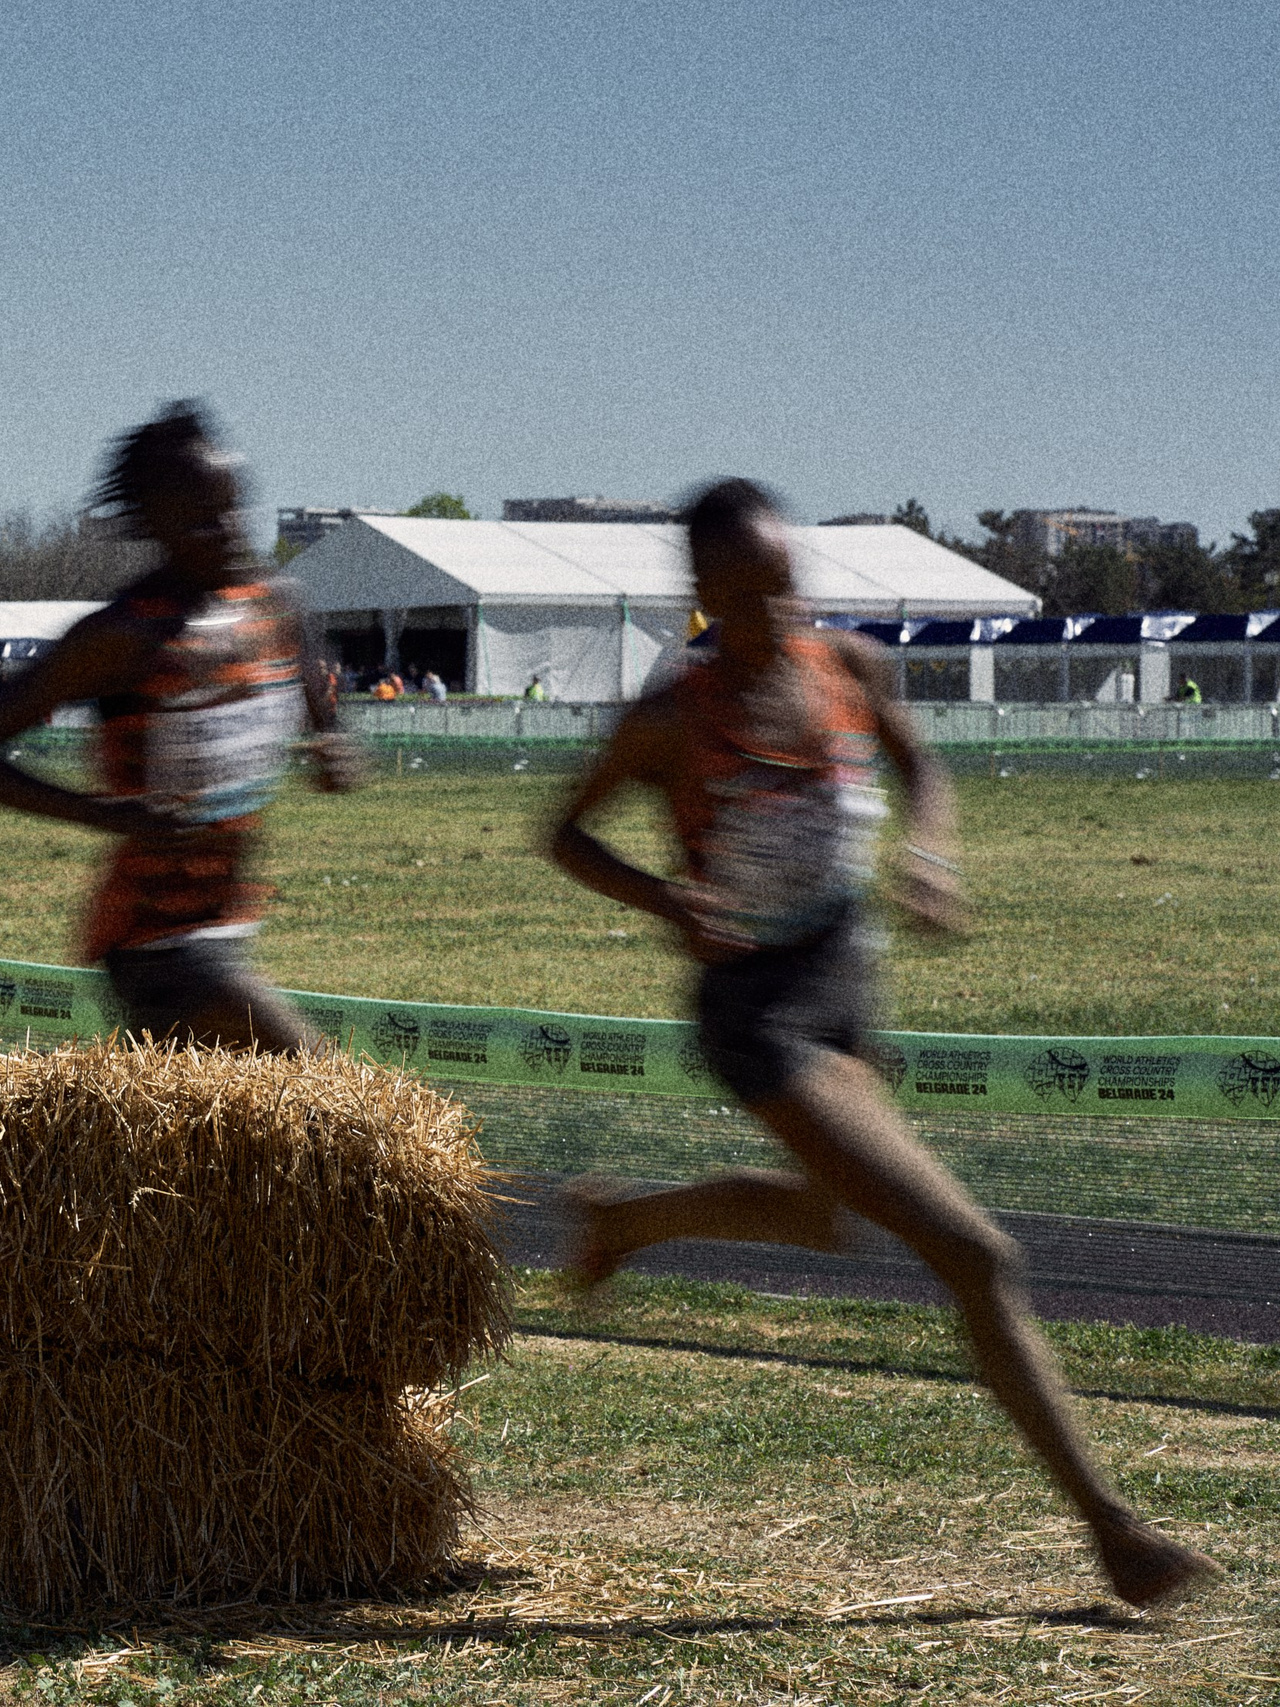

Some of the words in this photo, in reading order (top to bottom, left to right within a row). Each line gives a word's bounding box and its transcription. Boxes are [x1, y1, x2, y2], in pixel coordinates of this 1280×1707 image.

[428, 1050, 472, 1063] BELGRADE
[474, 1053, 488, 1064] 24
[920, 1050, 947, 1059] WORLD
[948, 1051, 991, 1061] ATHLETICS
[1103, 1055, 1133, 1065] WORLD
[1134, 1056, 1181, 1066] ATHLETICS
[580, 1062, 629, 1075] BELGRADE
[631, 1065, 644, 1076] 24
[917, 1060, 945, 1070] CROSS
[947, 1061, 989, 1071] COUNTRY
[1099, 1065, 1131, 1075] CROSS
[1132, 1066, 1178, 1076] COUNTRY
[915, 1070, 988, 1082] CHAMPIONSHIPS
[1097, 1076, 1175, 1087] CHAMPIONSHIPS
[915, 1082, 970, 1095] BELGRADE
[972, 1084, 987, 1096] 24
[1097, 1088, 1157, 1100] BELGRADE
[1158, 1088, 1175, 1101] 24
